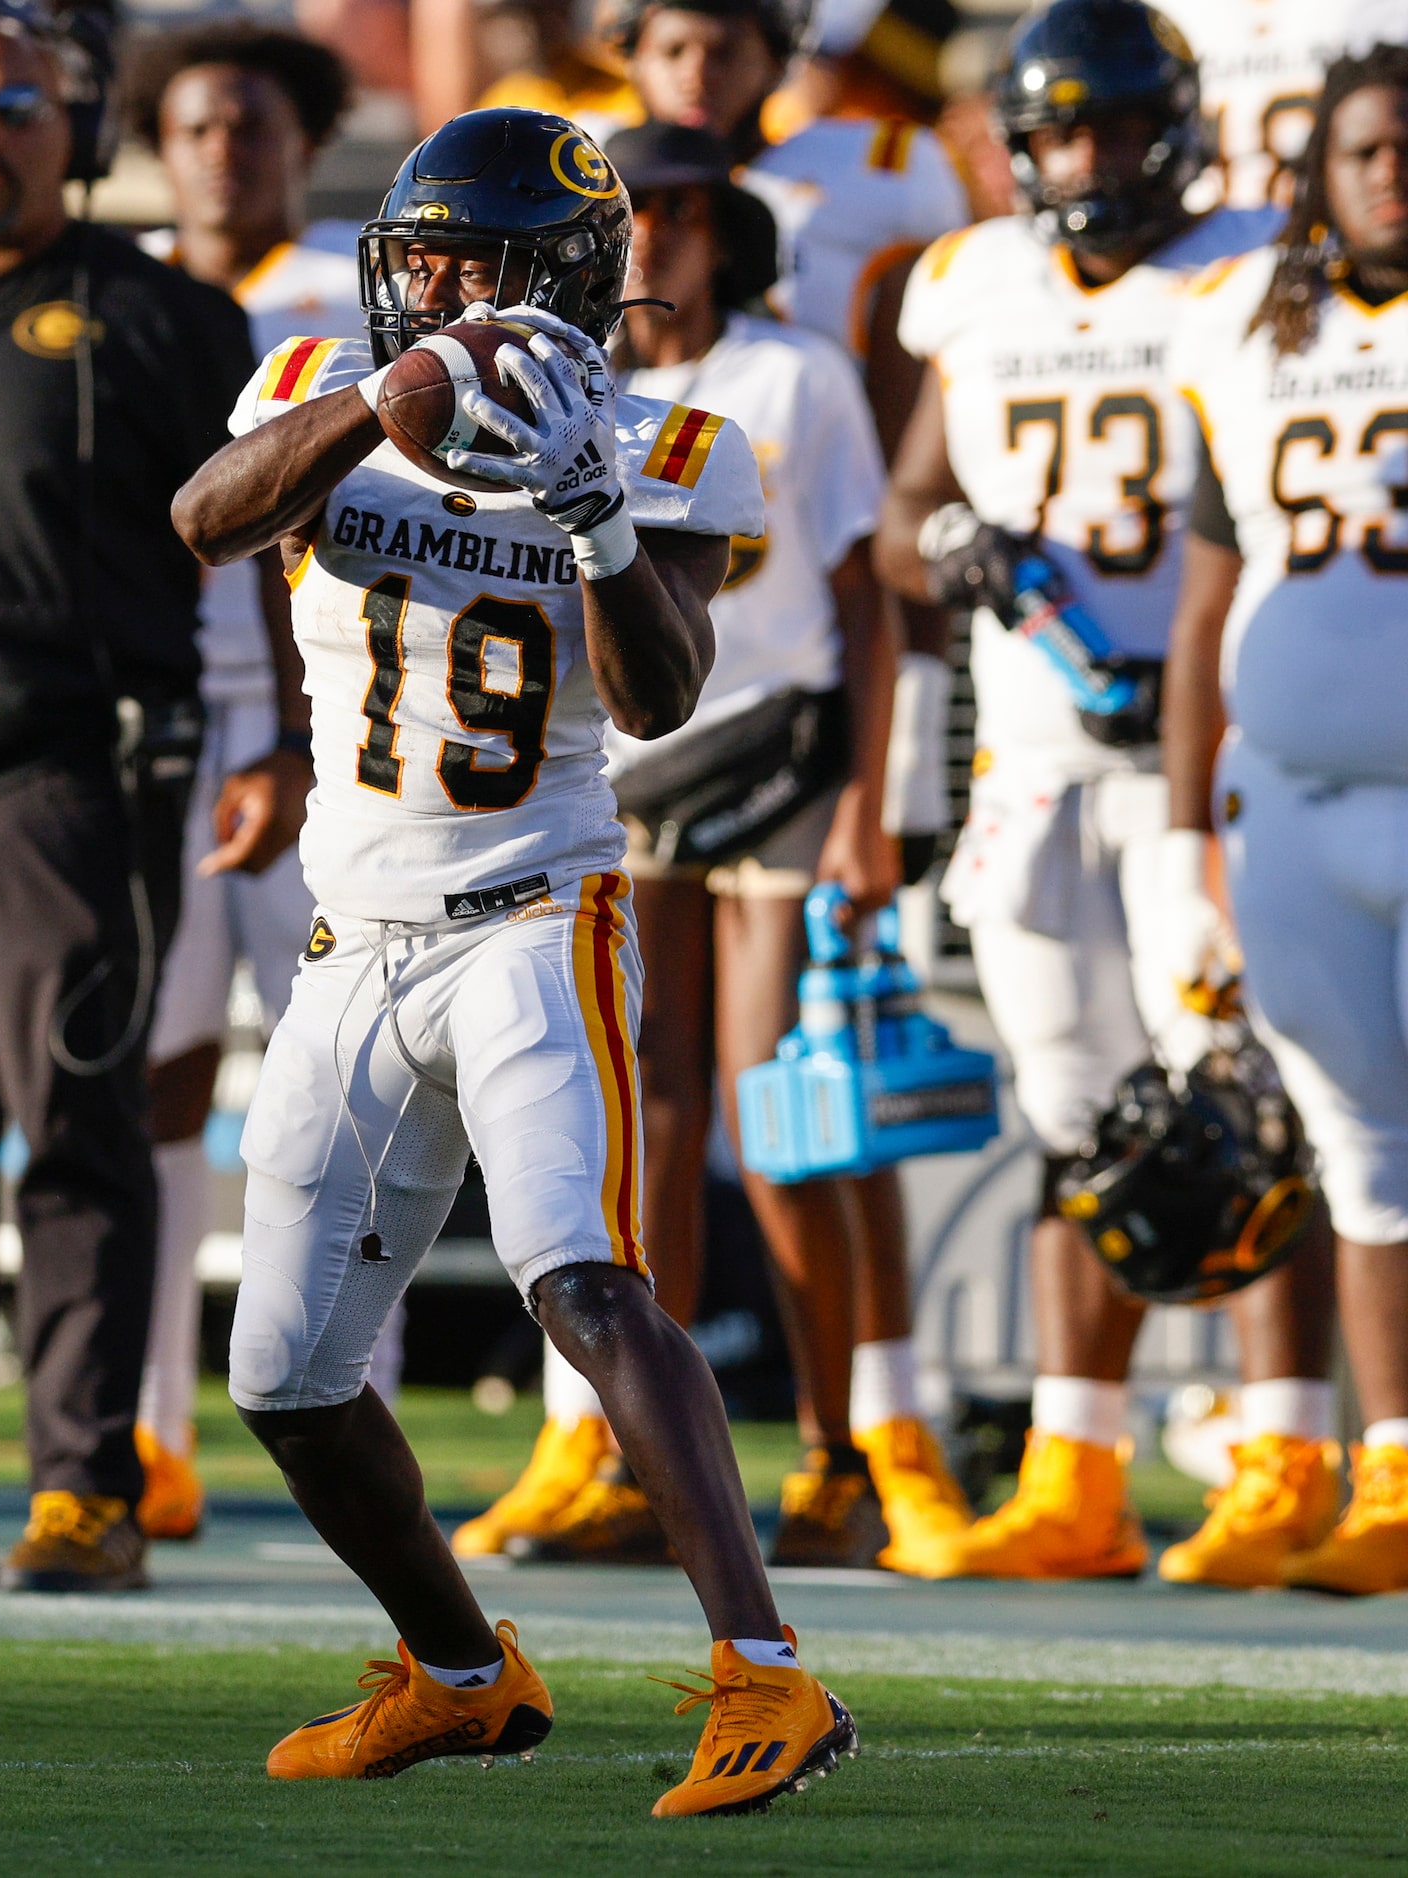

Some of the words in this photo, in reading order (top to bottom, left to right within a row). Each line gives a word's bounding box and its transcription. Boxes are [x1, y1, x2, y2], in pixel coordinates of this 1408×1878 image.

[1005, 393, 1164, 577] 73
[333, 506, 578, 585] GRAMBLING
[355, 571, 557, 811] 19
[451, 908, 481, 918] adidas
[494, 898, 505, 907] M
[506, 903, 564, 922] adidas
